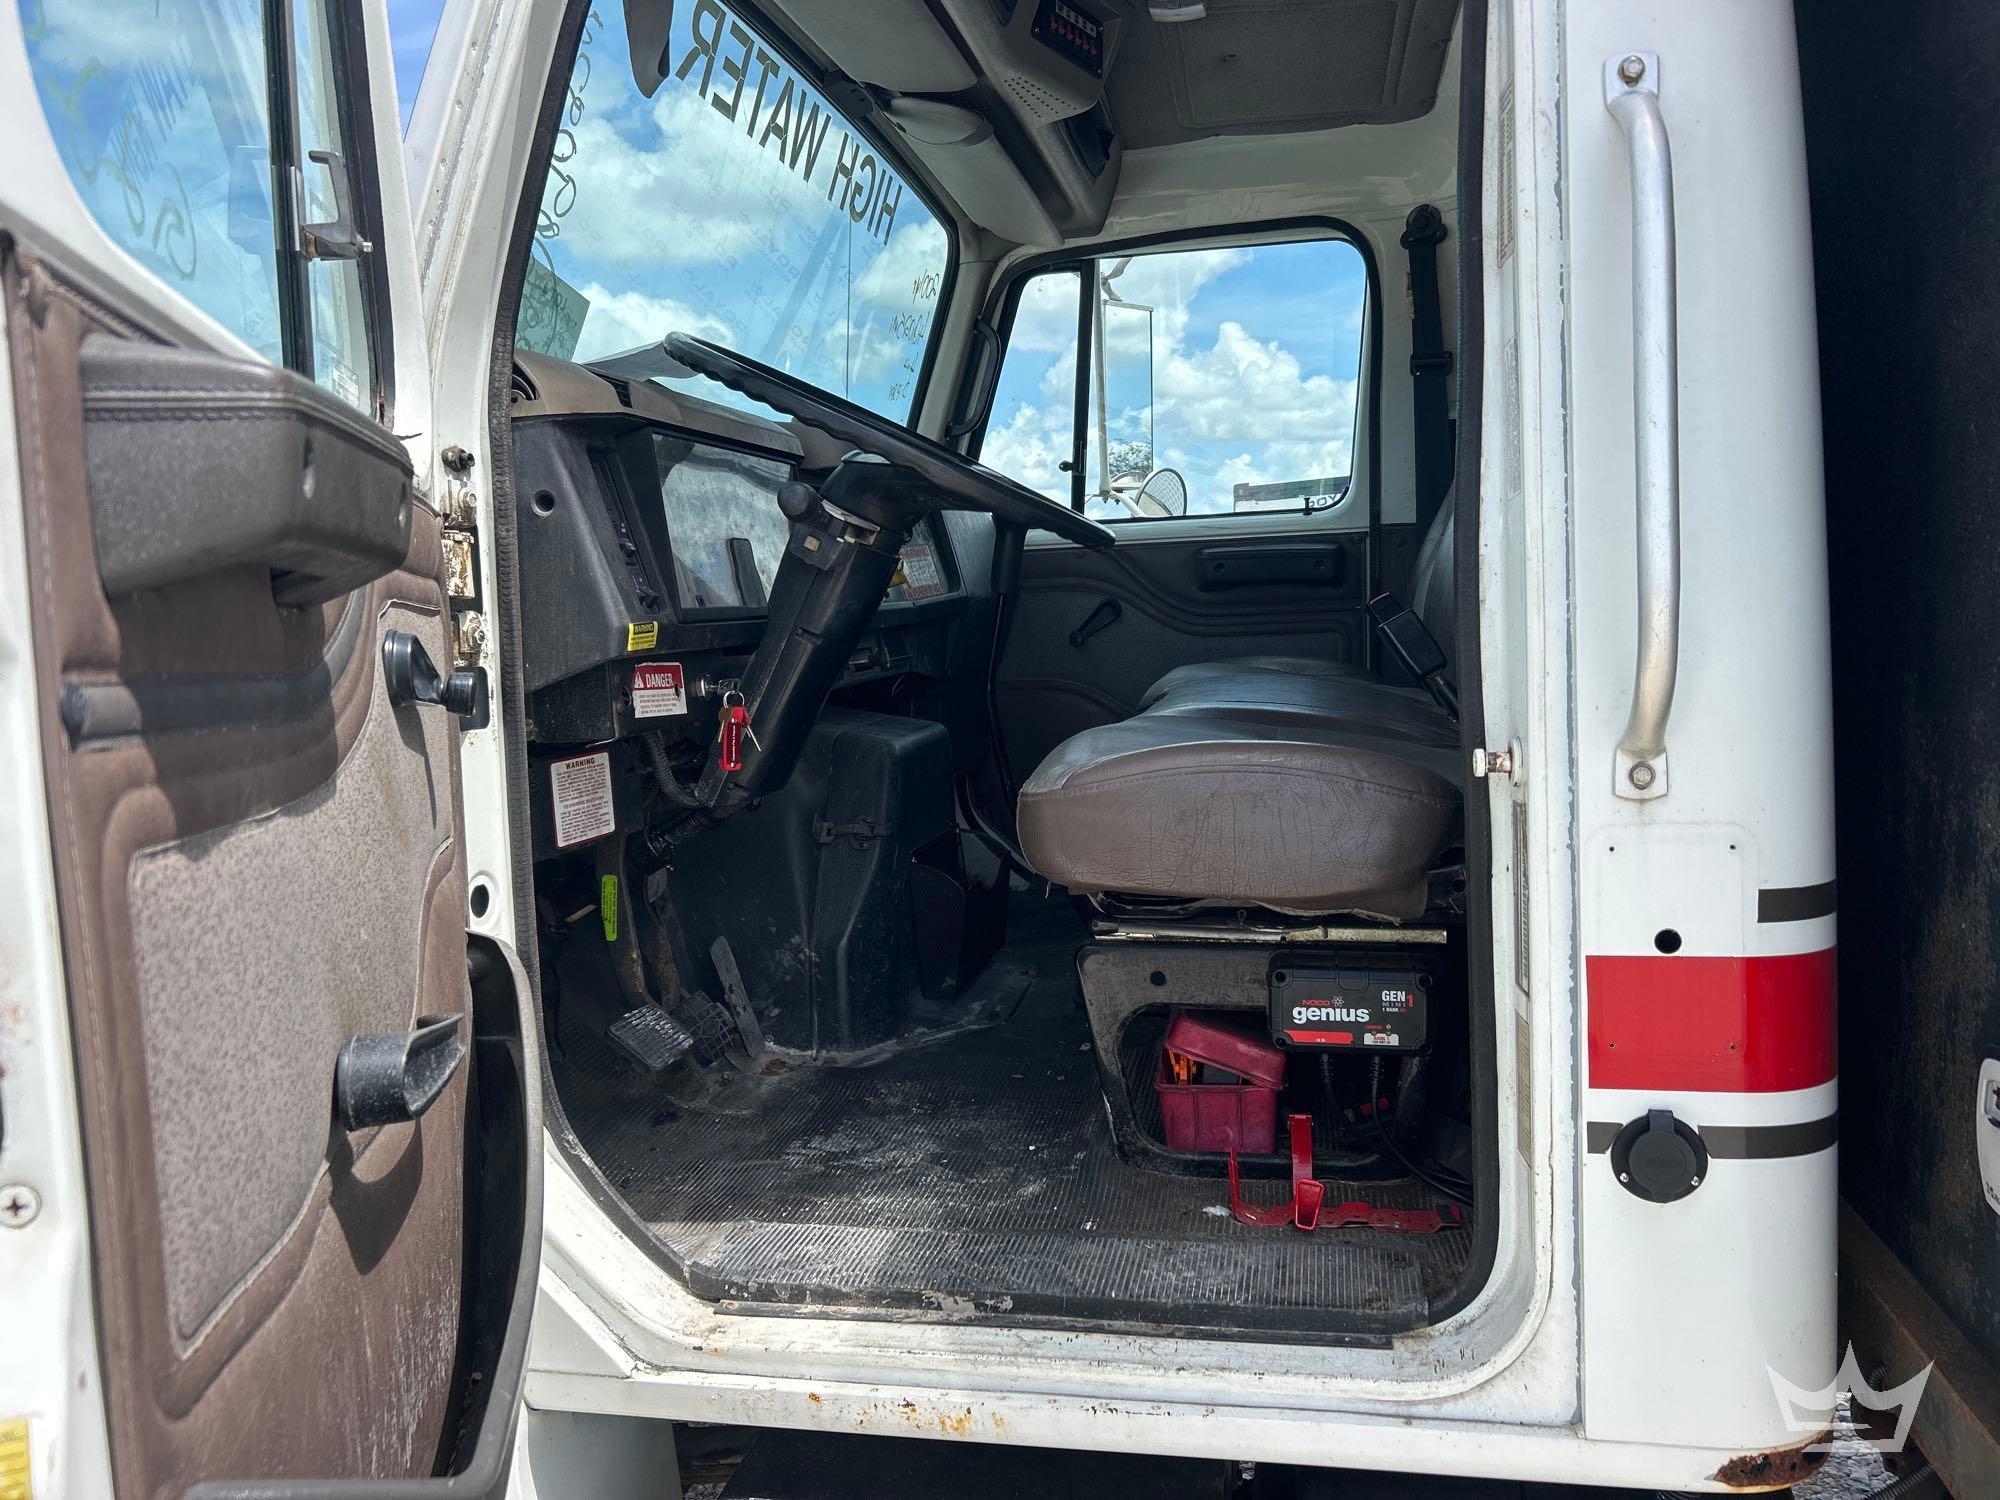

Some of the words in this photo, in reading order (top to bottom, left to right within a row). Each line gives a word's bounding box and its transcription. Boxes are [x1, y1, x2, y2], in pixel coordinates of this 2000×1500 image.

[634, 623, 653, 633] WARNING
[645, 672, 673, 688] DANGER
[565, 756, 595, 770] WARNING
[1381, 990, 1406, 1002] GEN
[1407, 993, 1414, 1007] 1
[1292, 1006, 1370, 1025] genius
